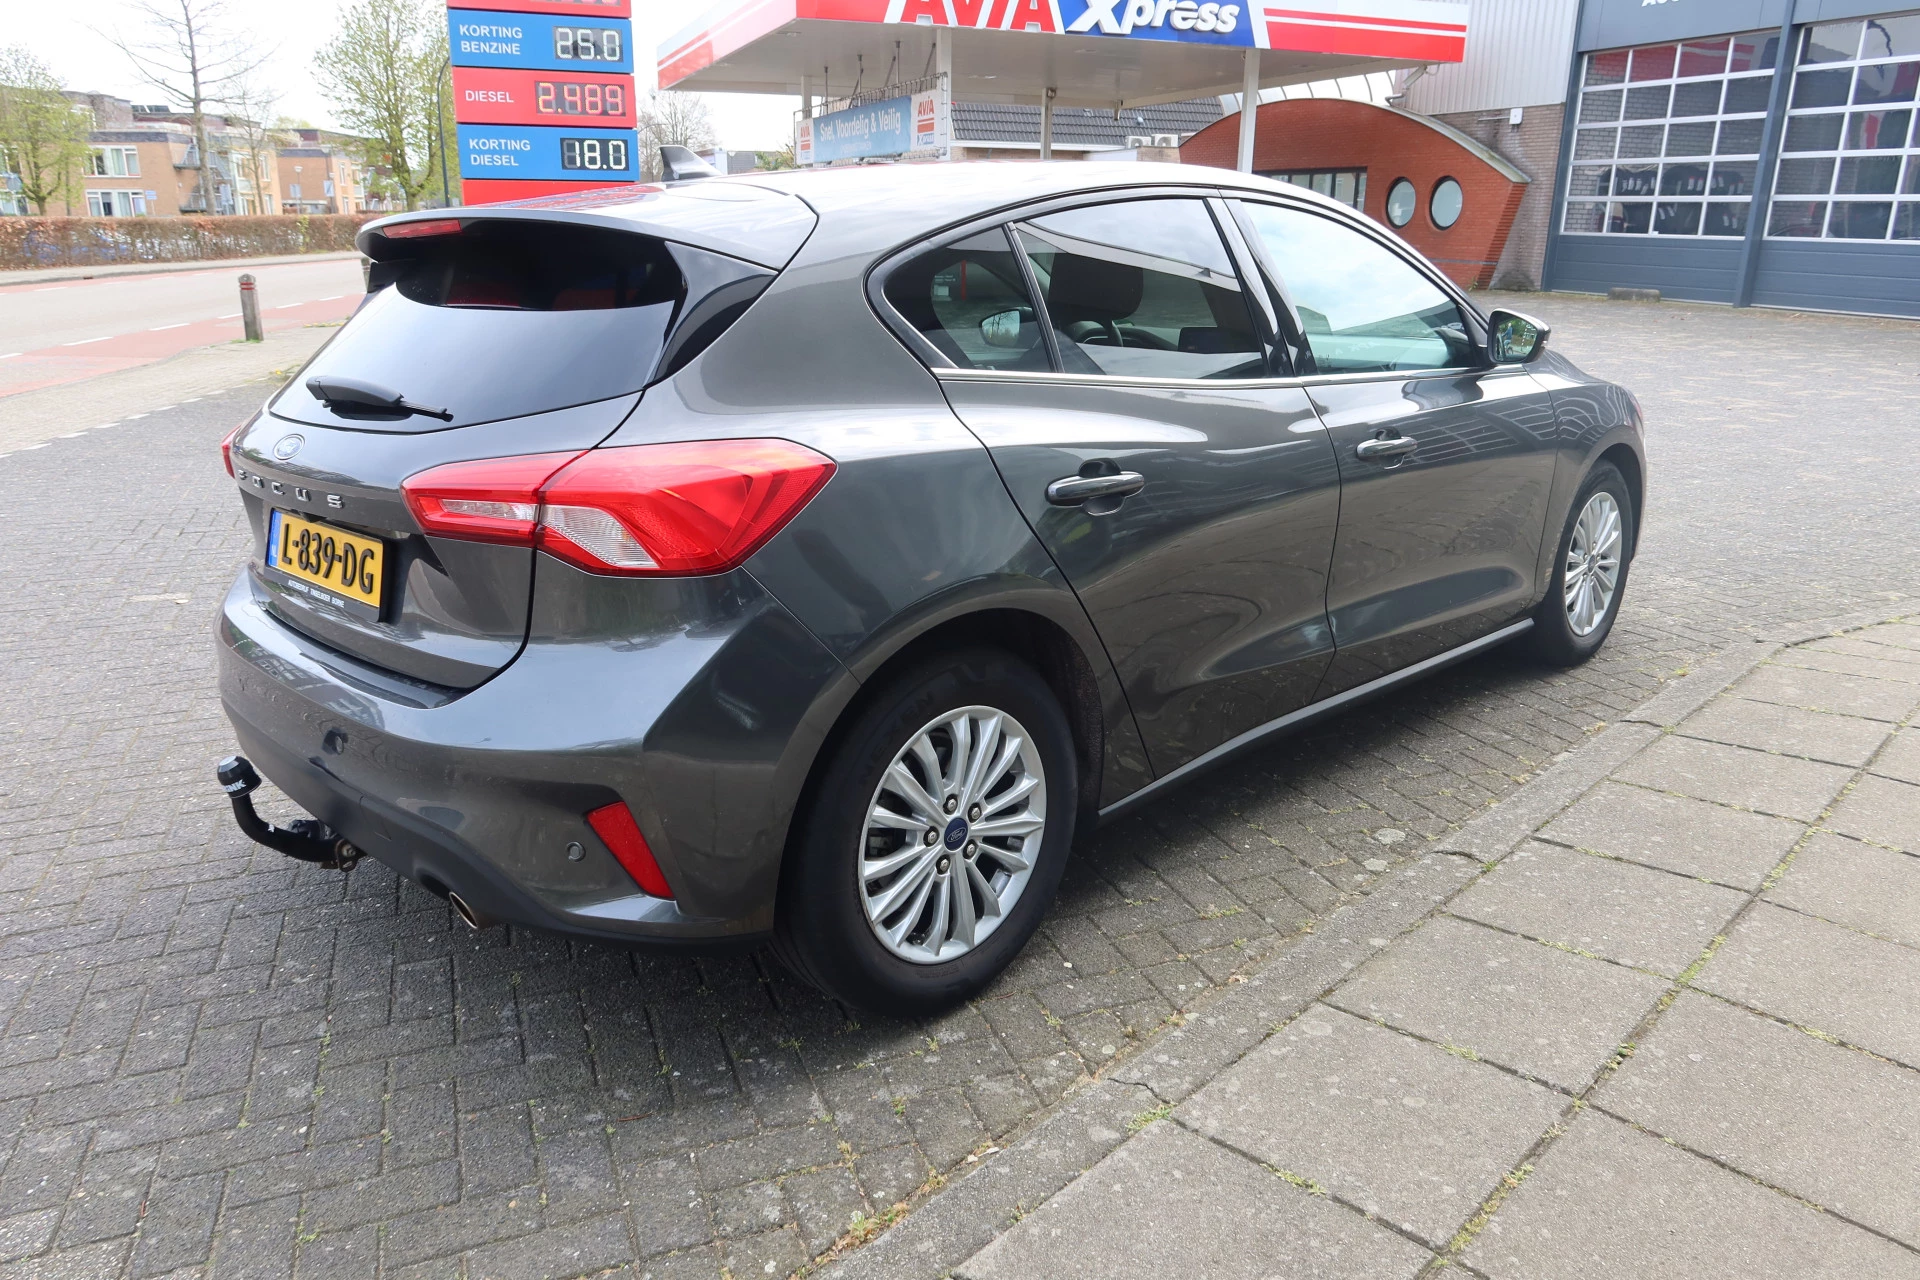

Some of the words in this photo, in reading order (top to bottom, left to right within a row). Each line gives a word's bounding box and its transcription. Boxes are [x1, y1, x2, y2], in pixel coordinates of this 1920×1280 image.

[459, 24, 523, 39] KORTING
[1065, 0, 1241, 35] Xpress
[461, 40, 521, 55] BENZINE
[556, 27, 620, 61] 25.0
[465, 90, 514, 103] DIESEL
[538, 82, 623, 115] 2.489
[917, 99, 935, 117] AVIA
[836, 114, 869, 139] Voordelig
[870, 112, 877, 133] &
[878, 107, 901, 134] Veilig
[469, 138, 531, 151] KORTING
[574, 139, 626, 170] 18.0
[470, 154, 519, 167] DIESEL
[238, 469, 344, 509] FOCUS
[281, 522, 375, 595] L-839-DG
